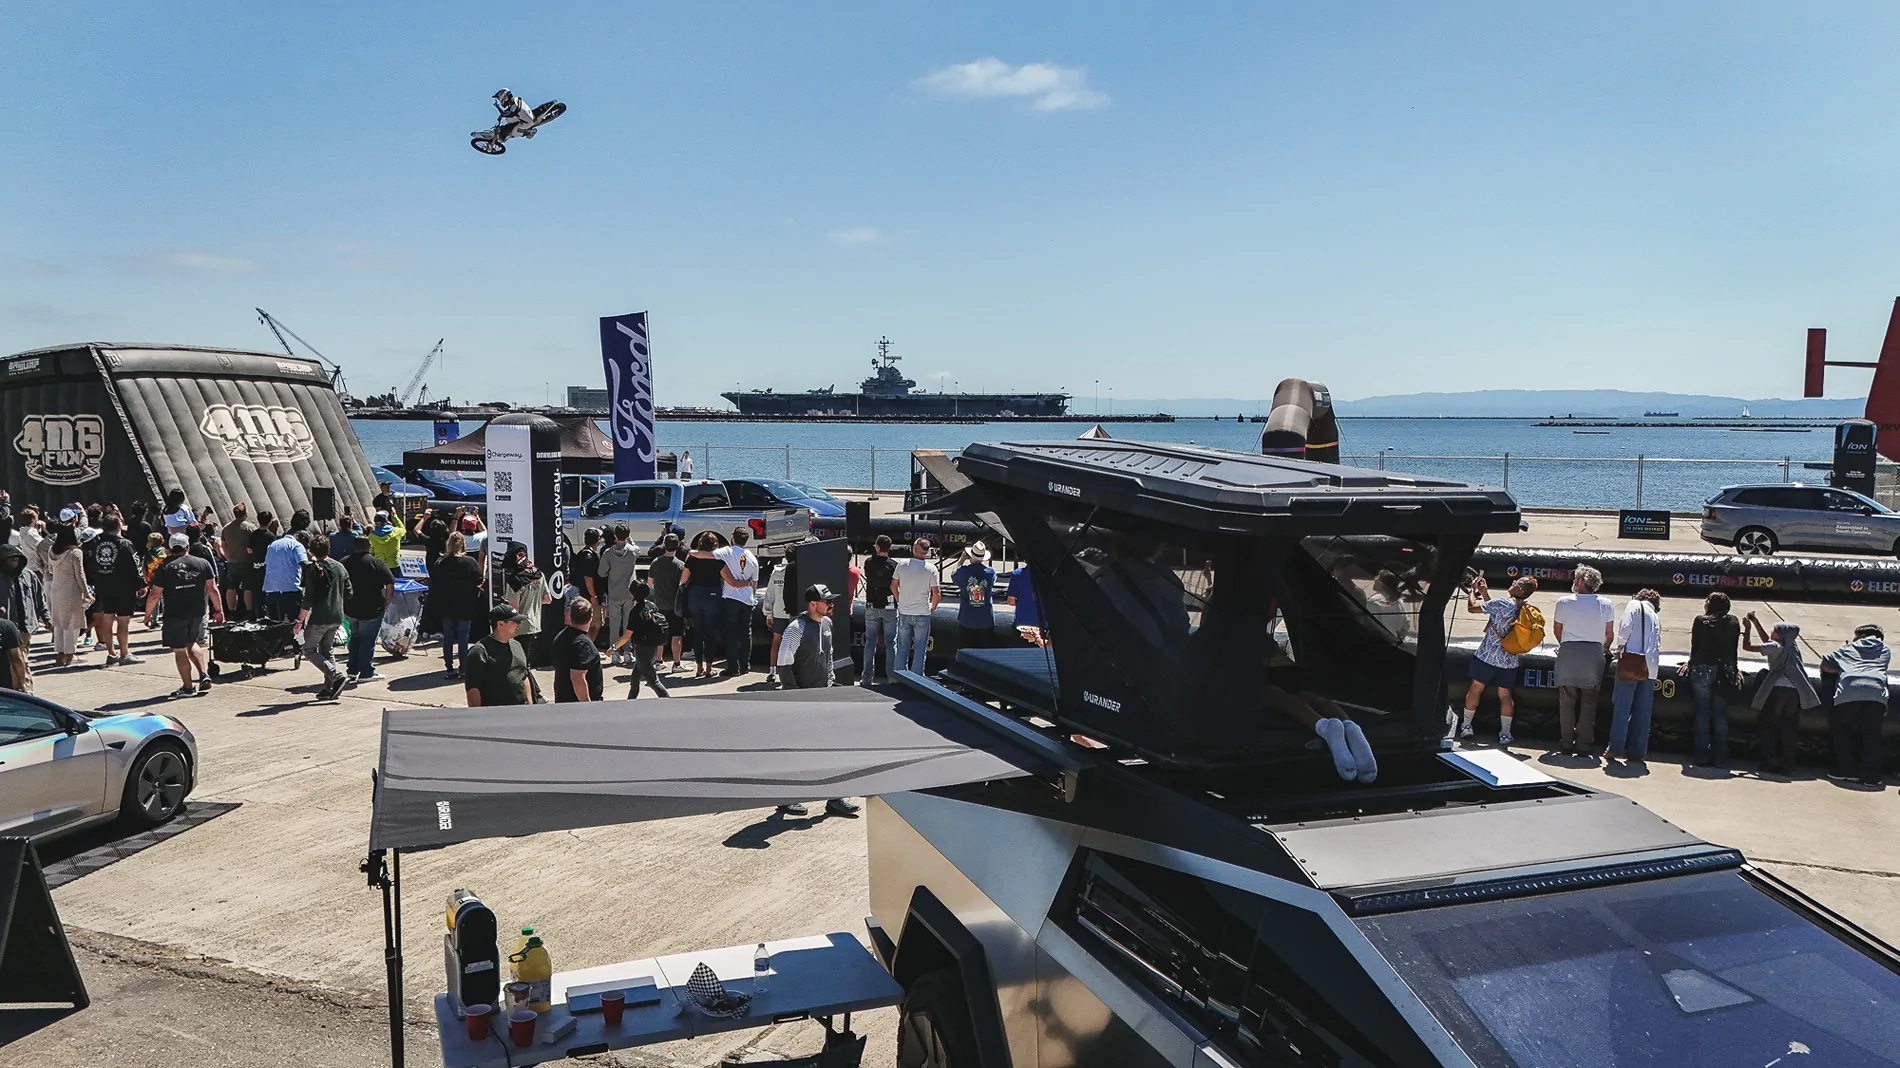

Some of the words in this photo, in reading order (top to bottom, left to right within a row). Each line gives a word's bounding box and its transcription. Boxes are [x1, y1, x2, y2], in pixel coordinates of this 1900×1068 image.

[608, 321, 653, 463] Ford
[45, 450, 82, 467] FMX
[1746, 576, 1774, 588] EXPO
